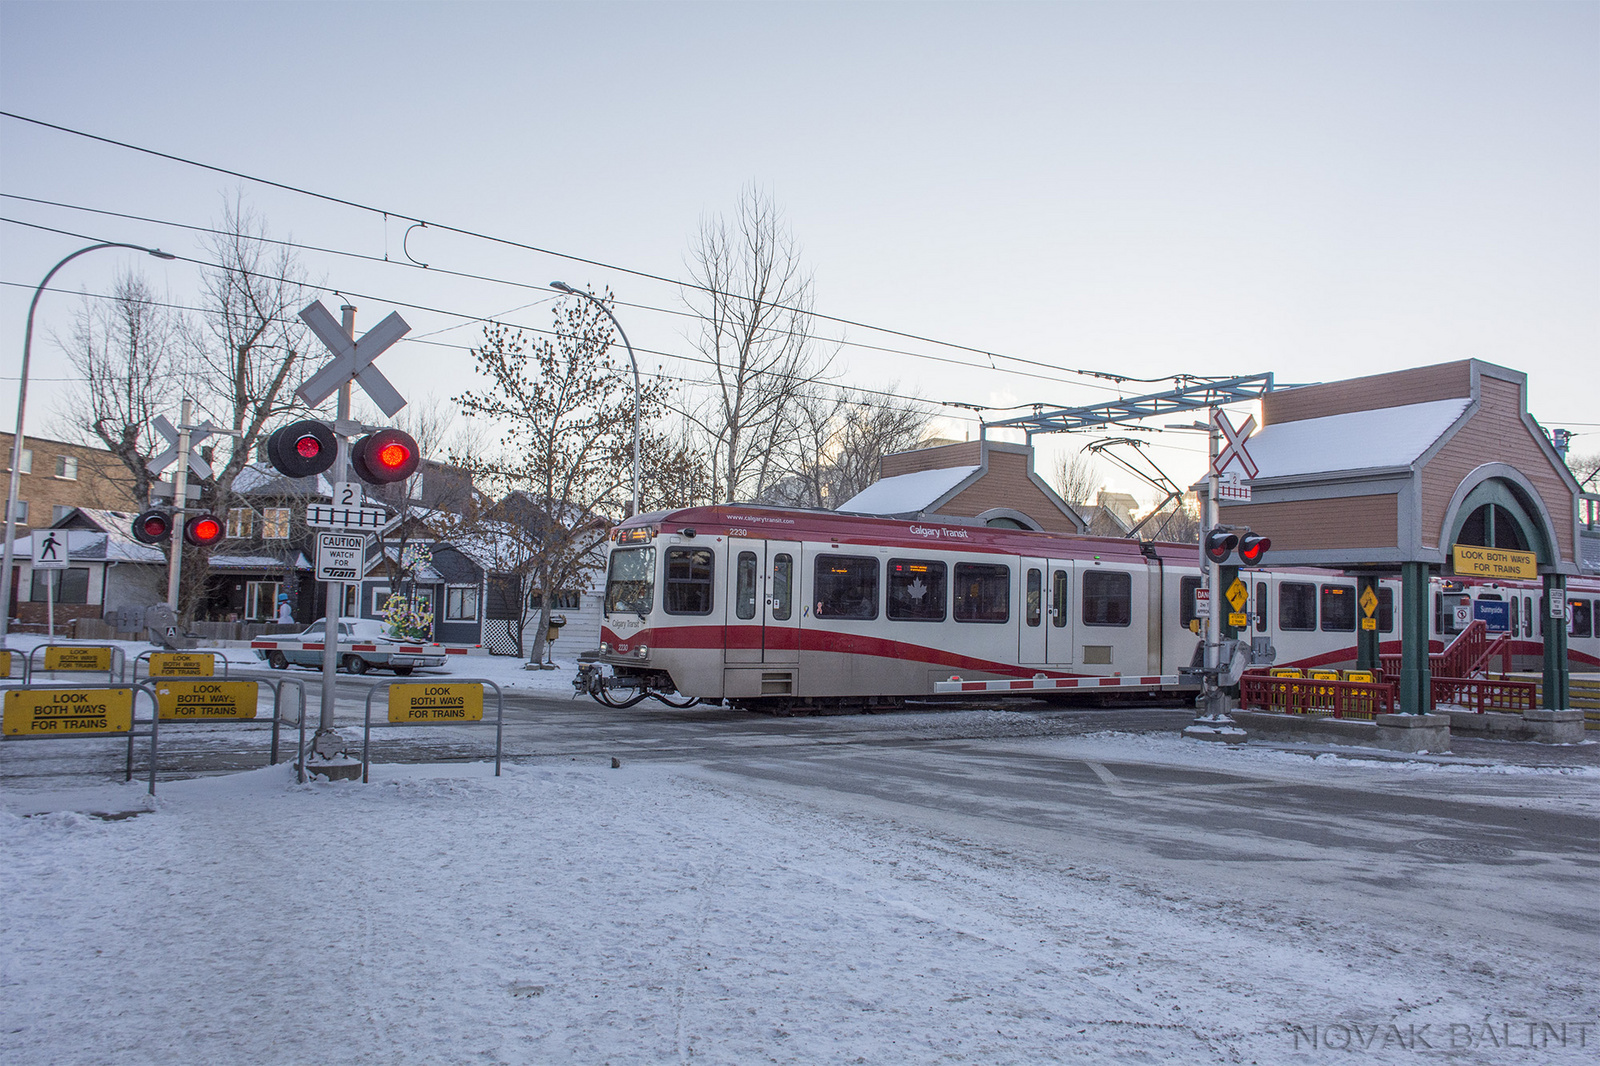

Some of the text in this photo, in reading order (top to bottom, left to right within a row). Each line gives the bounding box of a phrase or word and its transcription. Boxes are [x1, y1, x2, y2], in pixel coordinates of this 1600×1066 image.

[1232, 476, 1237, 484] 2
[342, 489, 353, 506] 2
[726, 514, 795, 524] www.calgarytransit.com
[730, 528, 748, 536] 2230
[910, 525, 968, 538] Calgary Transit
[322, 537, 361, 548] CAUTION
[330, 550, 354, 558] WATCH
[1461, 550, 1530, 564] LOOK BOTH WAYS
[322, 567, 356, 578] Train
[1474, 562, 1521, 574] FOR TRAINS
[1480, 606, 1502, 614] Sunnyside
[612, 620, 640, 629] Calgary Transit
[167, 627, 176, 636] A
[424, 688, 450, 696] LOOK
[53, 694, 88, 703] LOOK
[410, 696, 464, 706] BOTH WAYS
[34, 704, 106, 715] BOTH WAYS
[175, 706, 237, 715] FOR TRAINS
[408, 710, 465, 718] FOR TRAINS
[31, 719, 108, 730] FOR TRAINS
